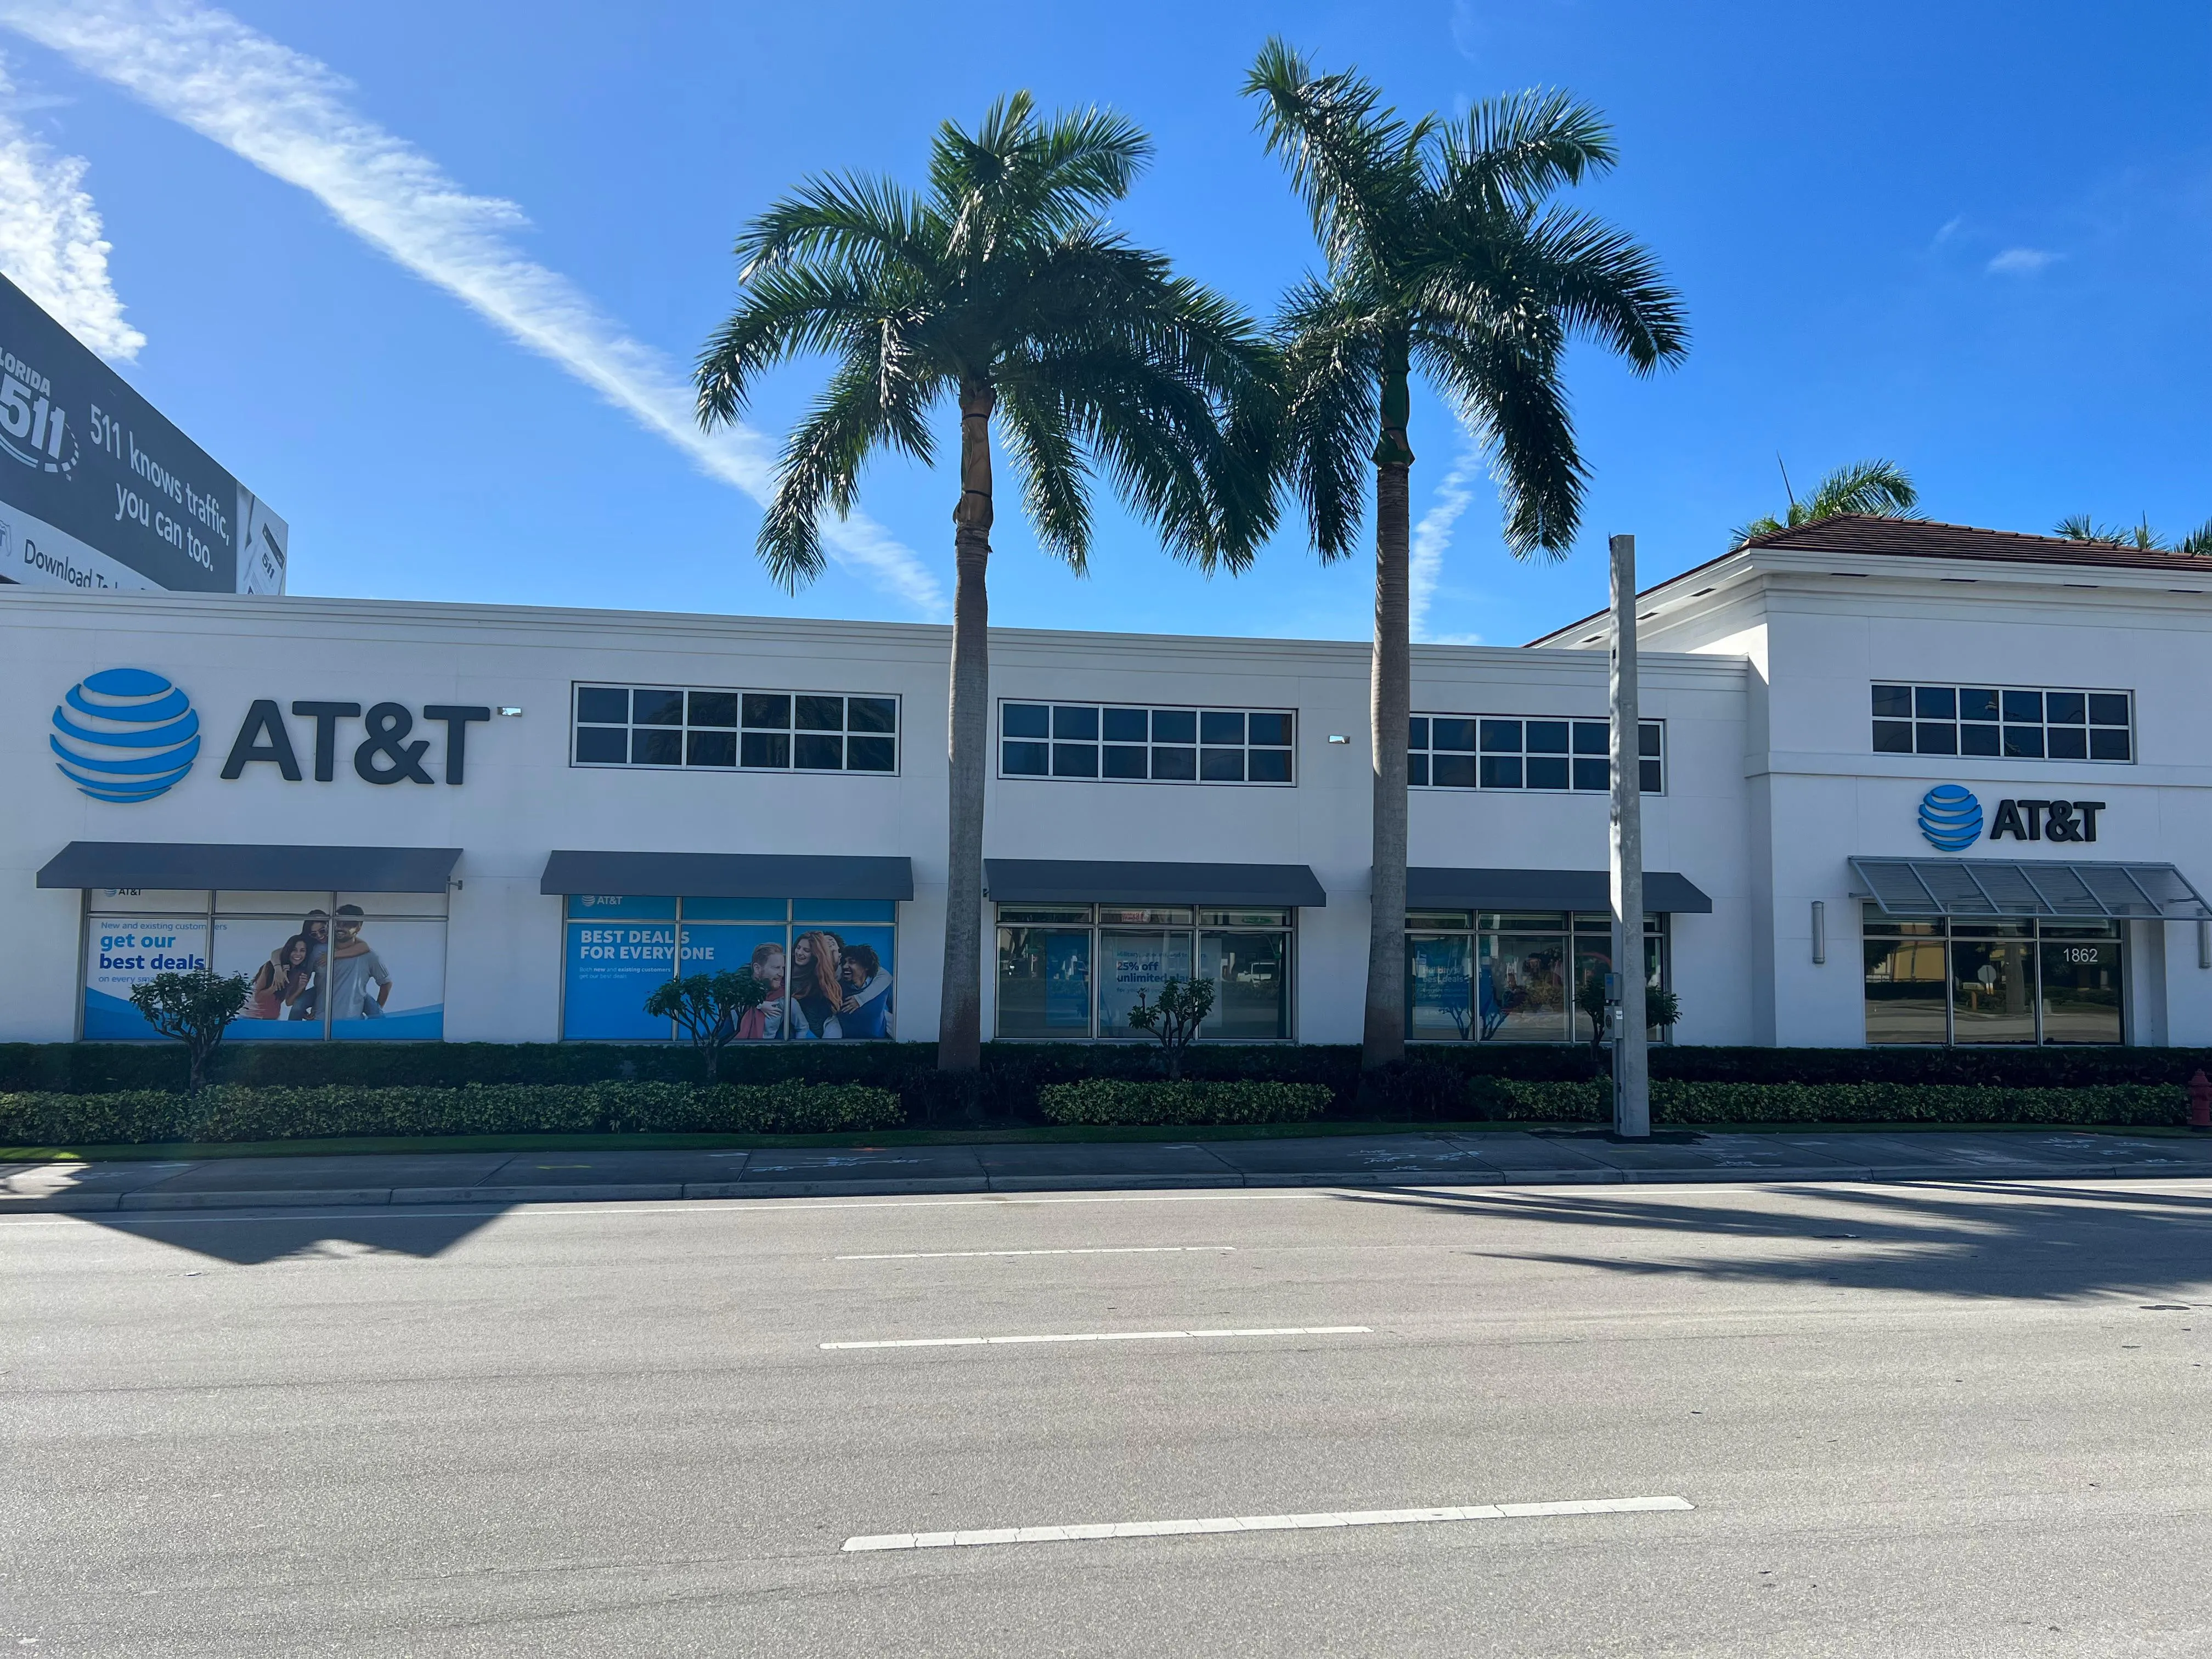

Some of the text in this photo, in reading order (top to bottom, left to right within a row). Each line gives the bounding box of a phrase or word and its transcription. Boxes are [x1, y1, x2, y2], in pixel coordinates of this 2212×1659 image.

[0, 373, 65, 460] 511
[90, 403, 229, 546] 511 knows traffic,
[115, 483, 213, 572] you can too.
[24, 539, 92, 588] Download
[262, 552, 275, 580] 511
[221, 699, 490, 785] AT&T
[1990, 799, 2106, 842] AT&T
[597, 896, 623, 905] AT&T
[140, 922, 173, 931] existing
[100, 934, 176, 952] get our
[581, 930, 690, 944] BEST DEALS
[99, 953, 205, 970] best deals
[580, 946, 715, 960] FOR EVERYONE
[2063, 947, 2098, 962] 1862
[1117, 962, 1159, 971] 25% off
[1117, 973, 1167, 983] unlimited
